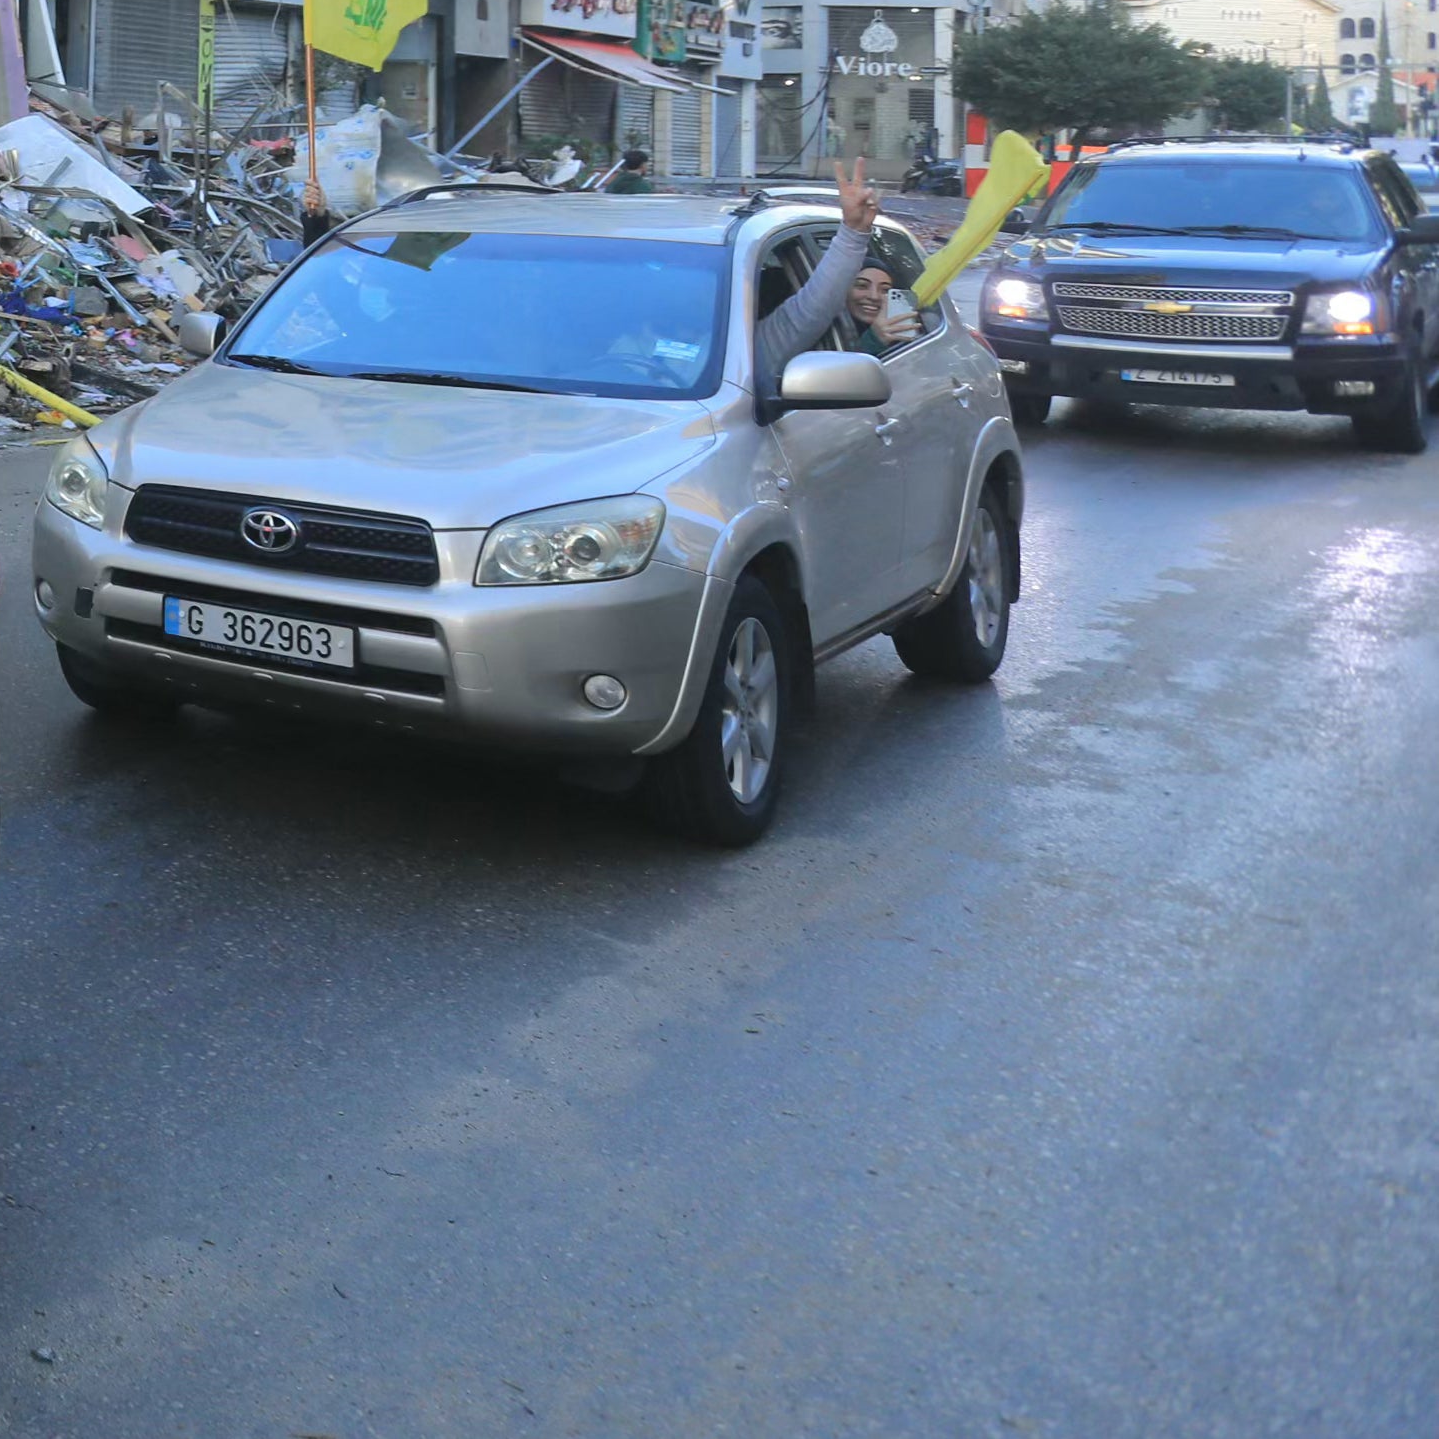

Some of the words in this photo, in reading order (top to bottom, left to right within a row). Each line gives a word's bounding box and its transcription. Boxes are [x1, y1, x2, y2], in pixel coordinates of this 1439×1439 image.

[836, 56, 913, 77] Viore
[187, 605, 204, 635] G
[223, 611, 332, 659] 362963
